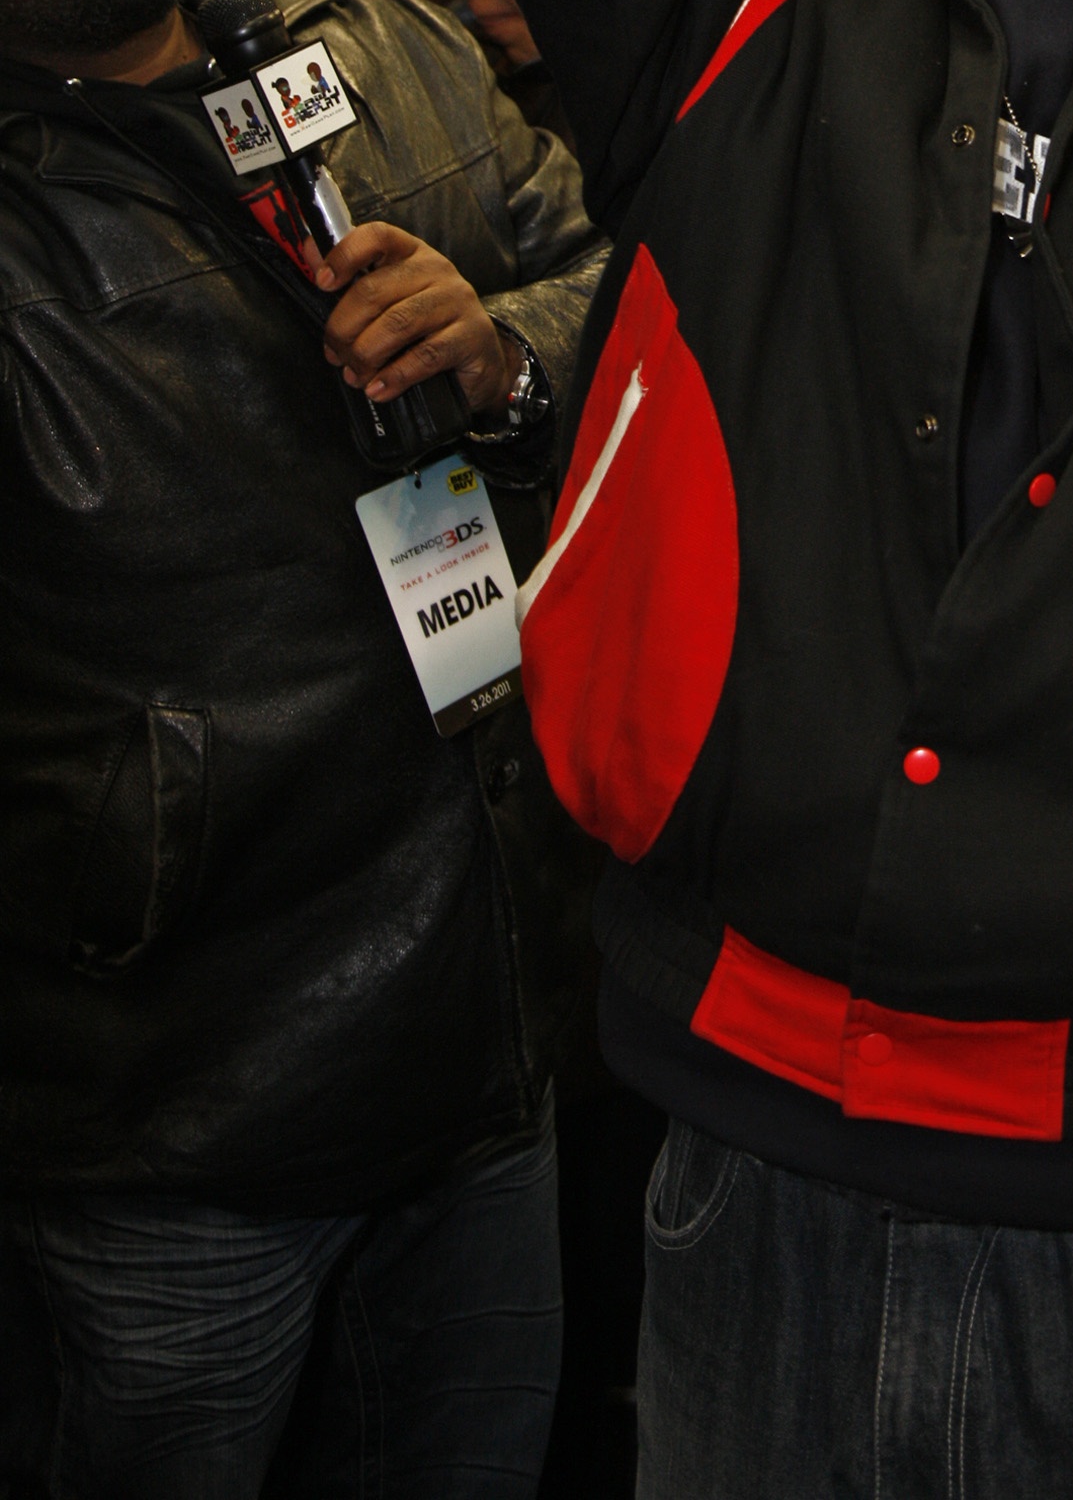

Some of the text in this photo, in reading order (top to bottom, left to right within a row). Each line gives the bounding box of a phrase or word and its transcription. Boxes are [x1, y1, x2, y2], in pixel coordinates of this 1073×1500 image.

[450, 469, 474, 483] BEST
[453, 478, 474, 493] BUY
[390, 516, 484, 566] NINTENDO 3DS
[400, 542, 491, 591] TAKE A LOOK INSIDE
[416, 574, 504, 639] MEDIA
[470, 680, 512, 713] 3.26.2011
